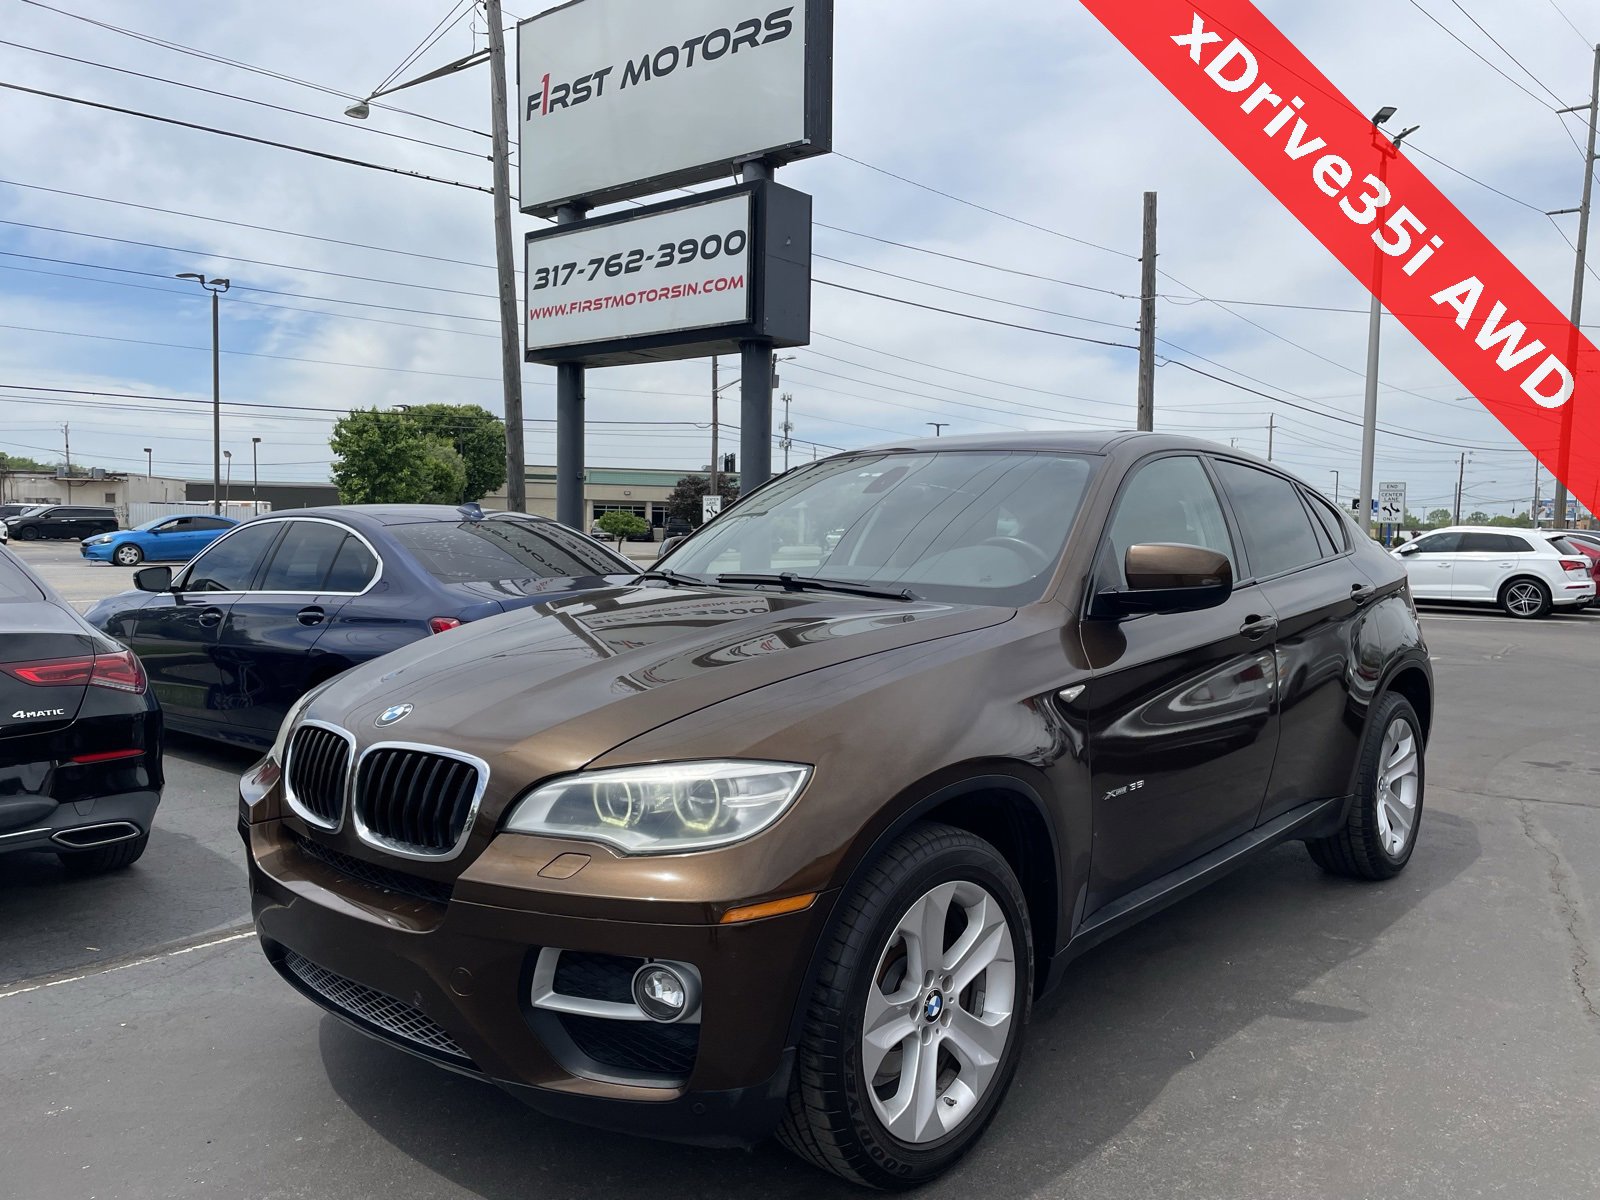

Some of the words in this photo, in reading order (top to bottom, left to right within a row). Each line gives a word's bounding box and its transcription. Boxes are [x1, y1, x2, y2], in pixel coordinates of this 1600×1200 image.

[620, 6, 794, 89] MOTORS
[533, 229, 747, 290] 317-762-3900
[530, 275, 744, 320] WWW.FIRSTMOTORSIN.COM
[12, 708, 65, 719] 4MATIC
